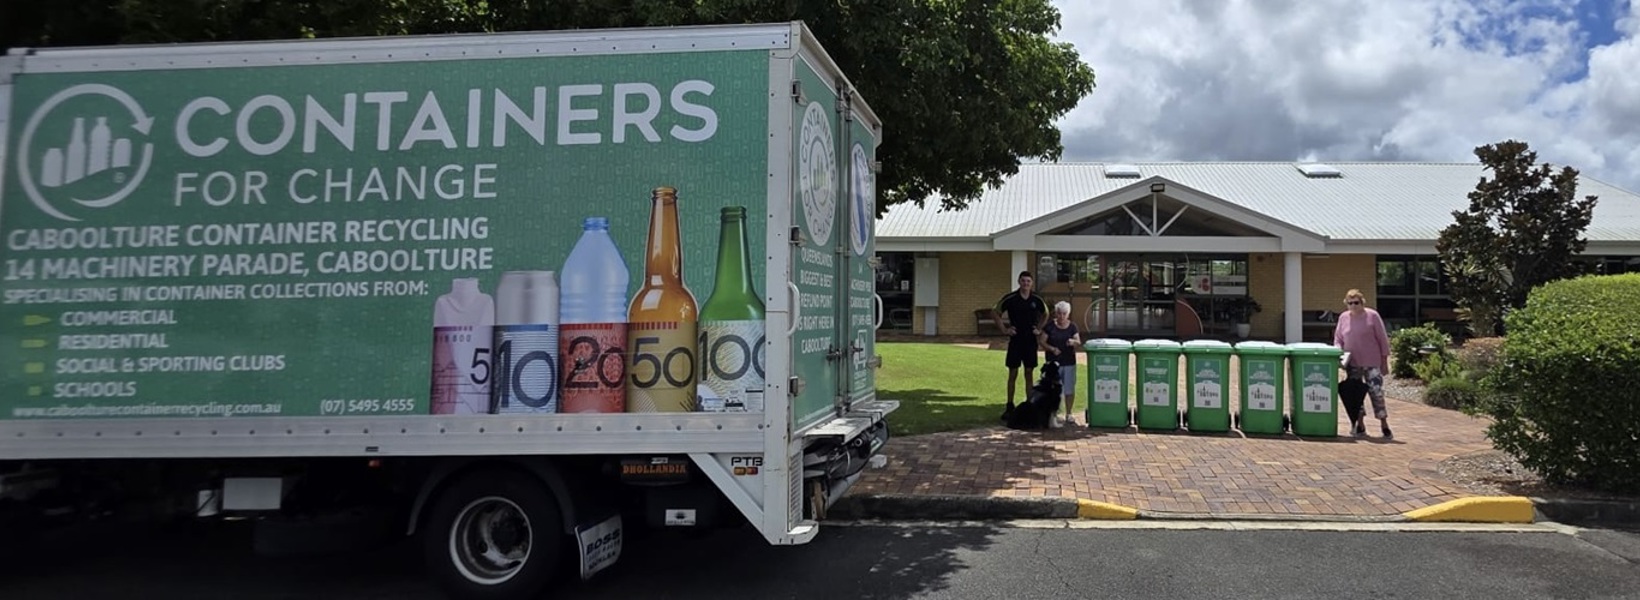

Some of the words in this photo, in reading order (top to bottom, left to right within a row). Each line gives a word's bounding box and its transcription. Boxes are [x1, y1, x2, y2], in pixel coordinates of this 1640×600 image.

[175, 79, 719, 157] CONTAINERS
[174, 171, 269, 206] FOR
[288, 163, 498, 204] CHANGE
[7, 225, 181, 250] CABOOLTURE
[186, 221, 338, 246] CONTAINER
[344, 216, 489, 243] RECYCLING
[3, 258, 35, 281] 14
[41, 254, 197, 280] MACHINERY
[202, 251, 310, 277] PARADE,
[316, 247, 494, 274] CABOOLTURE
[3, 286, 118, 304] SPECIALISING
[122, 286, 141, 302] IN
[146, 284, 246, 301] CONTAINER
[250, 281, 369, 299] COLLECTIONS
[374, 280, 429, 297] FROM:
[60, 309, 178, 327] COMMERCIAL
[58, 333, 170, 350] RESIDENTIAL
[56, 357, 118, 374] SOCIAL
[123, 357, 135, 373] &
[137, 356, 225, 373] SPORTING
[229, 355, 286, 371] CLUBS
[469, 347, 490, 385] 5
[496, 339, 556, 408] 10
[564, 335, 625, 389] 20
[631, 337, 695, 389] 50
[53, 381, 137, 398] SCHOOLS
[320, 399, 346, 415] (07)
[348, 399, 380, 412] 5495
[382, 398, 415, 412] 4555
[622, 464, 686, 475] DHOLLANDIA
[731, 456, 764, 467] PTB
[586, 528, 621, 555] BOSS
